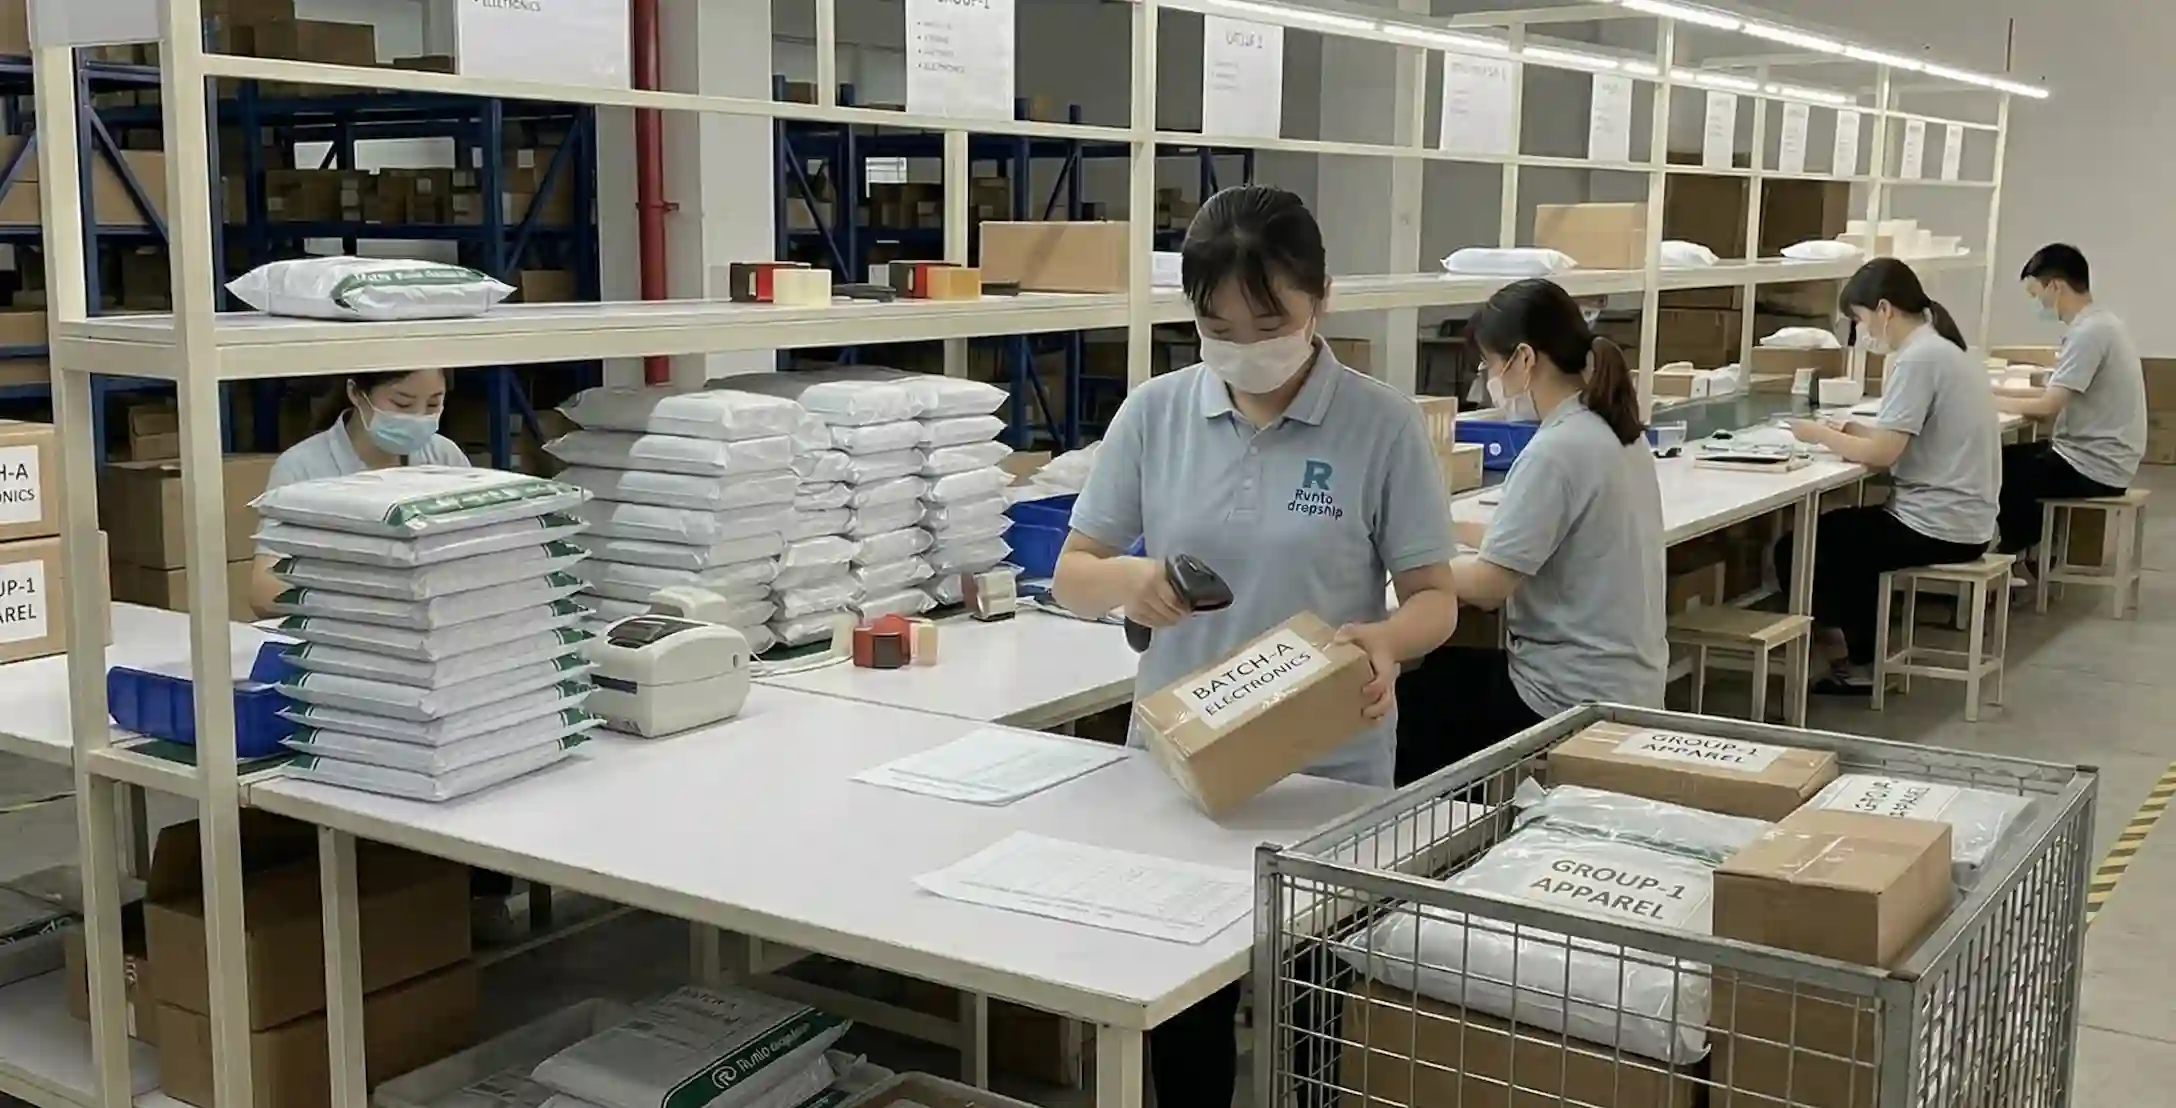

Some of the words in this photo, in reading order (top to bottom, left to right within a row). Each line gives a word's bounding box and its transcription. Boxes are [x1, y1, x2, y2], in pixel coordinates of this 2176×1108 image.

[1302, 459, 1333, 491] R
[0, 488, 35, 504] NICS
[1192, 642, 1294, 701] BATCH-A
[1204, 651, 1312, 717] ELECTRONICS
[1640, 743, 1747, 764] APPAREL
[1651, 733, 1759, 757] GROUP-1
[1551, 859, 1687, 900] GROUP-1
[1529, 877, 1665, 920] APPAREL
